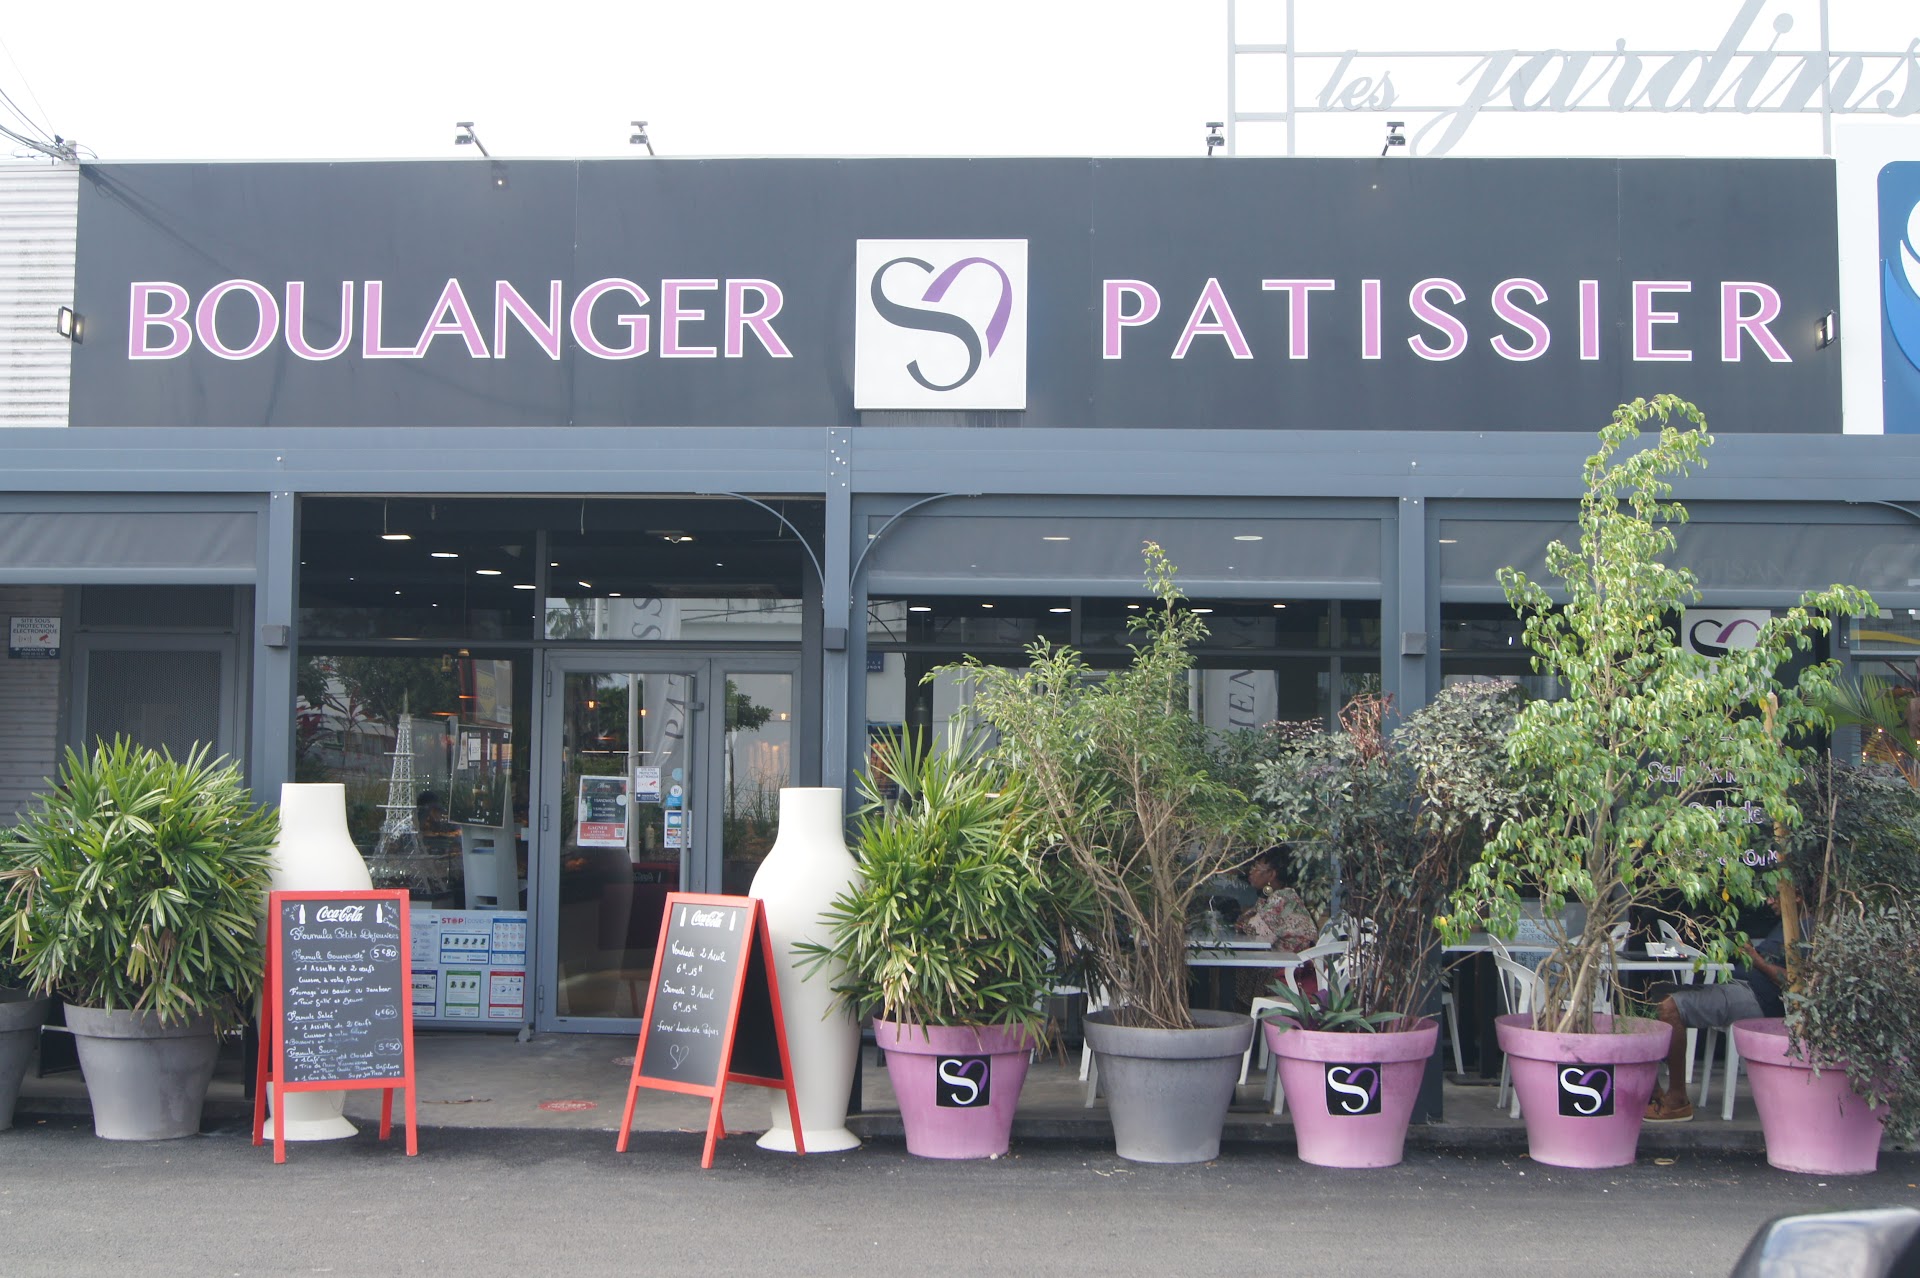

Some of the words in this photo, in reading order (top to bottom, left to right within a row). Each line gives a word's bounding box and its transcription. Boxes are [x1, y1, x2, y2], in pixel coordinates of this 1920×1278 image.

[1315, 49, 1399, 111] les
[128, 277, 796, 362] BOULANGER
[1102, 276, 1793, 365] PATISSIER
[316, 905, 366, 922] Coca-Cola
[691, 909, 726, 928] Coca-Cola
[672, 939, 695, 957] Vendredi
[699, 948, 707, 958] 2
[662, 979, 686, 995] Samedi
[690, 985, 696, 996] 3
